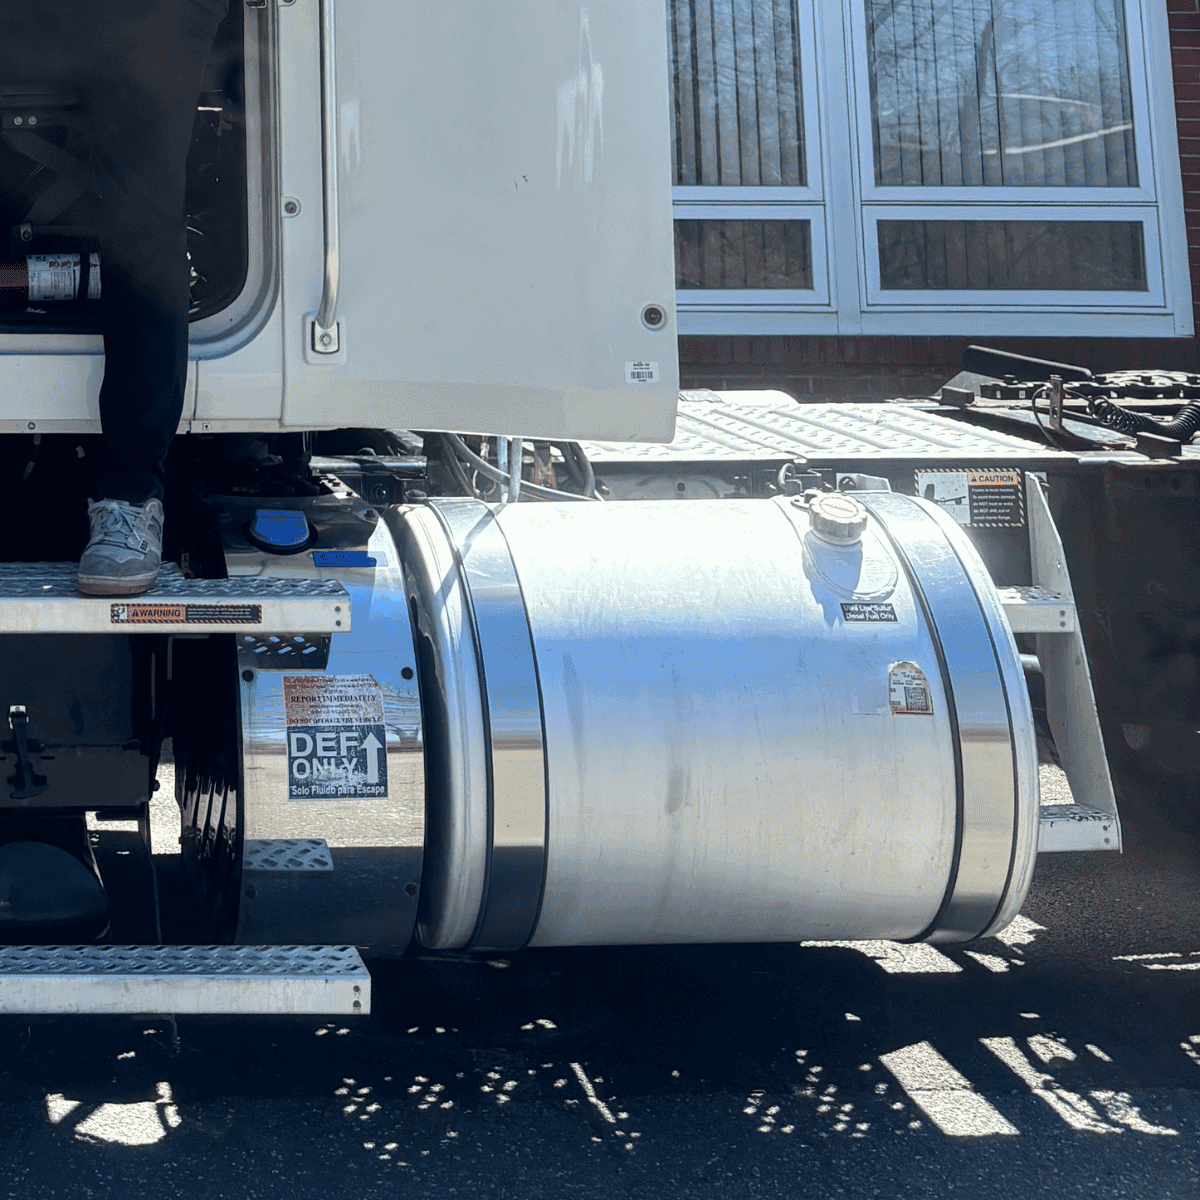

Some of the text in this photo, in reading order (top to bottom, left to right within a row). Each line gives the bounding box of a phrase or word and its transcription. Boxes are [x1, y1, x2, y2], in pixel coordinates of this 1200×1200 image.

[141, 609, 181, 617] WARNING
[290, 731, 359, 757] DEF
[292, 757, 358, 779] ONLY
[291, 786, 310, 796] Solo
[337, 787, 355, 796] para
[356, 785, 385, 796] Escape
